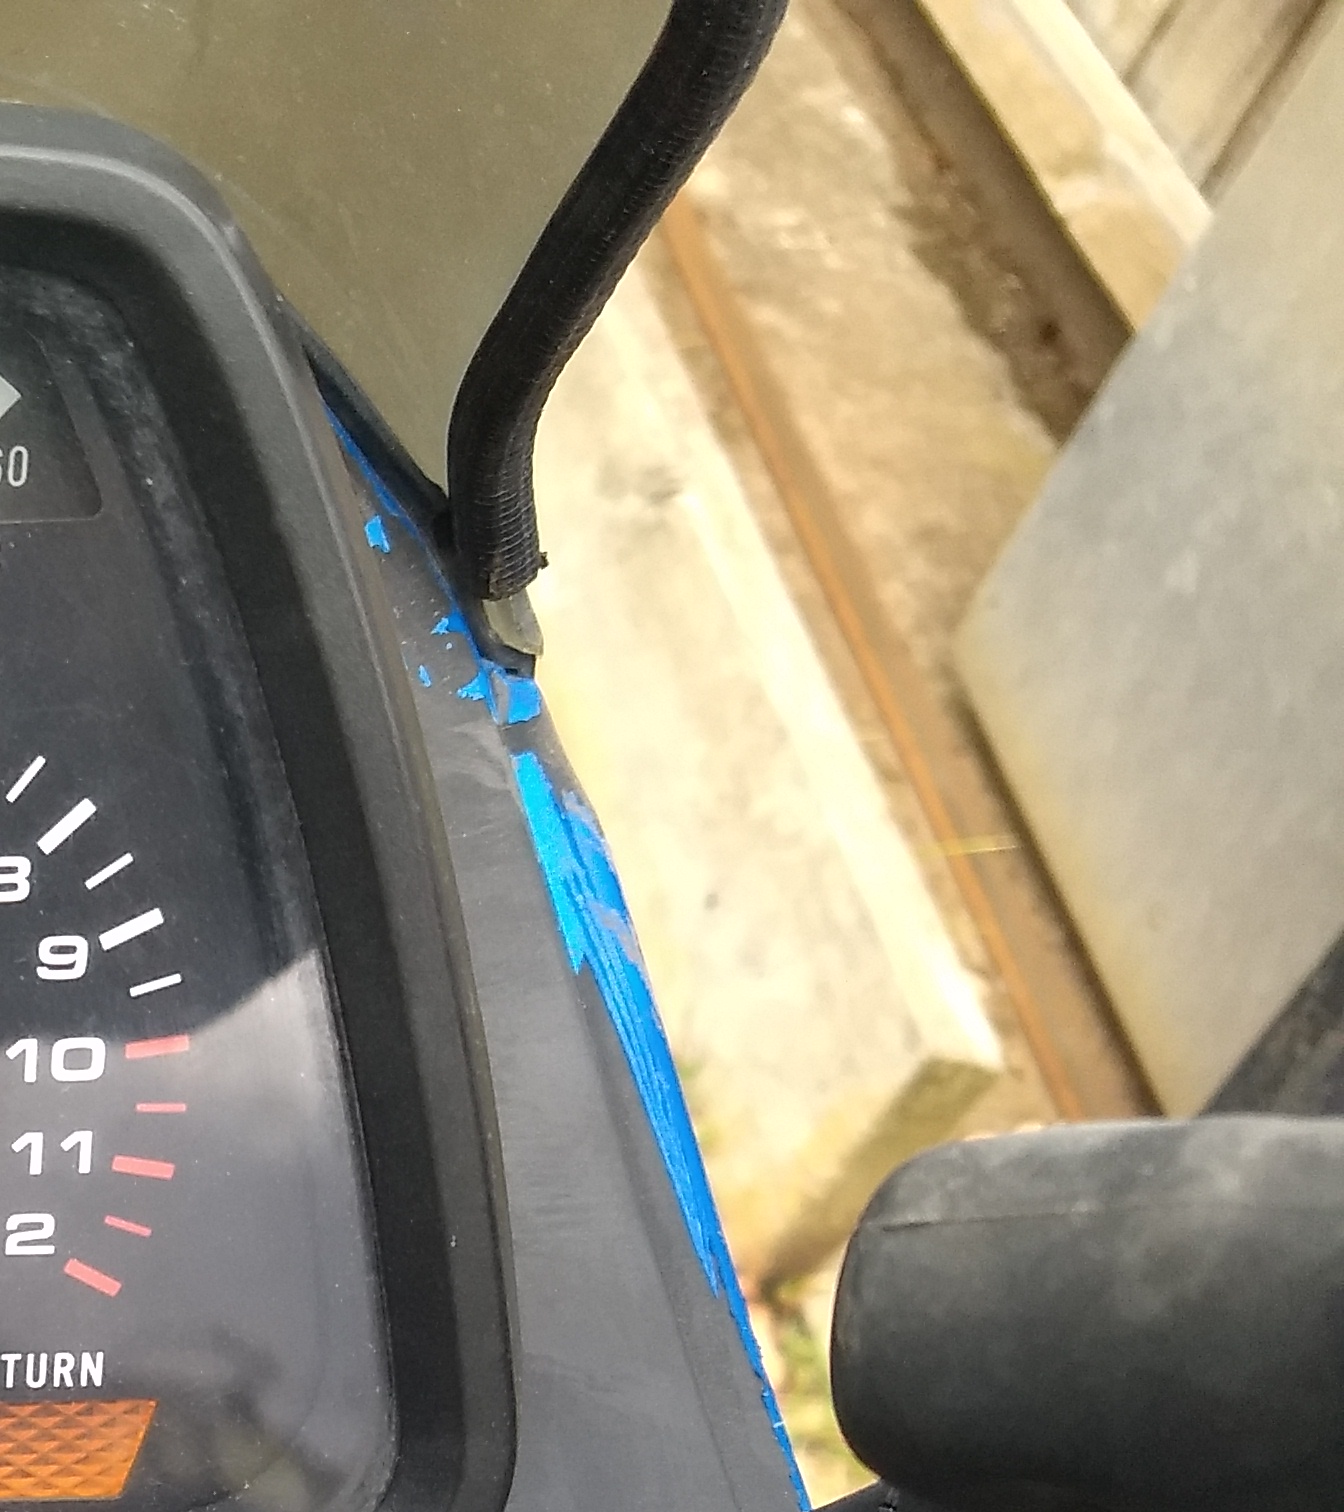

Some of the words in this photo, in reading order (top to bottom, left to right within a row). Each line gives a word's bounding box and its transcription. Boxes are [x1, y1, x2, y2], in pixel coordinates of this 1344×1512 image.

[36, 935, 89, 981] 9
[5, 1036, 106, 1083] 10
[11, 1130, 93, 1175] 11
[0, 1351, 104, 1389] TURN
